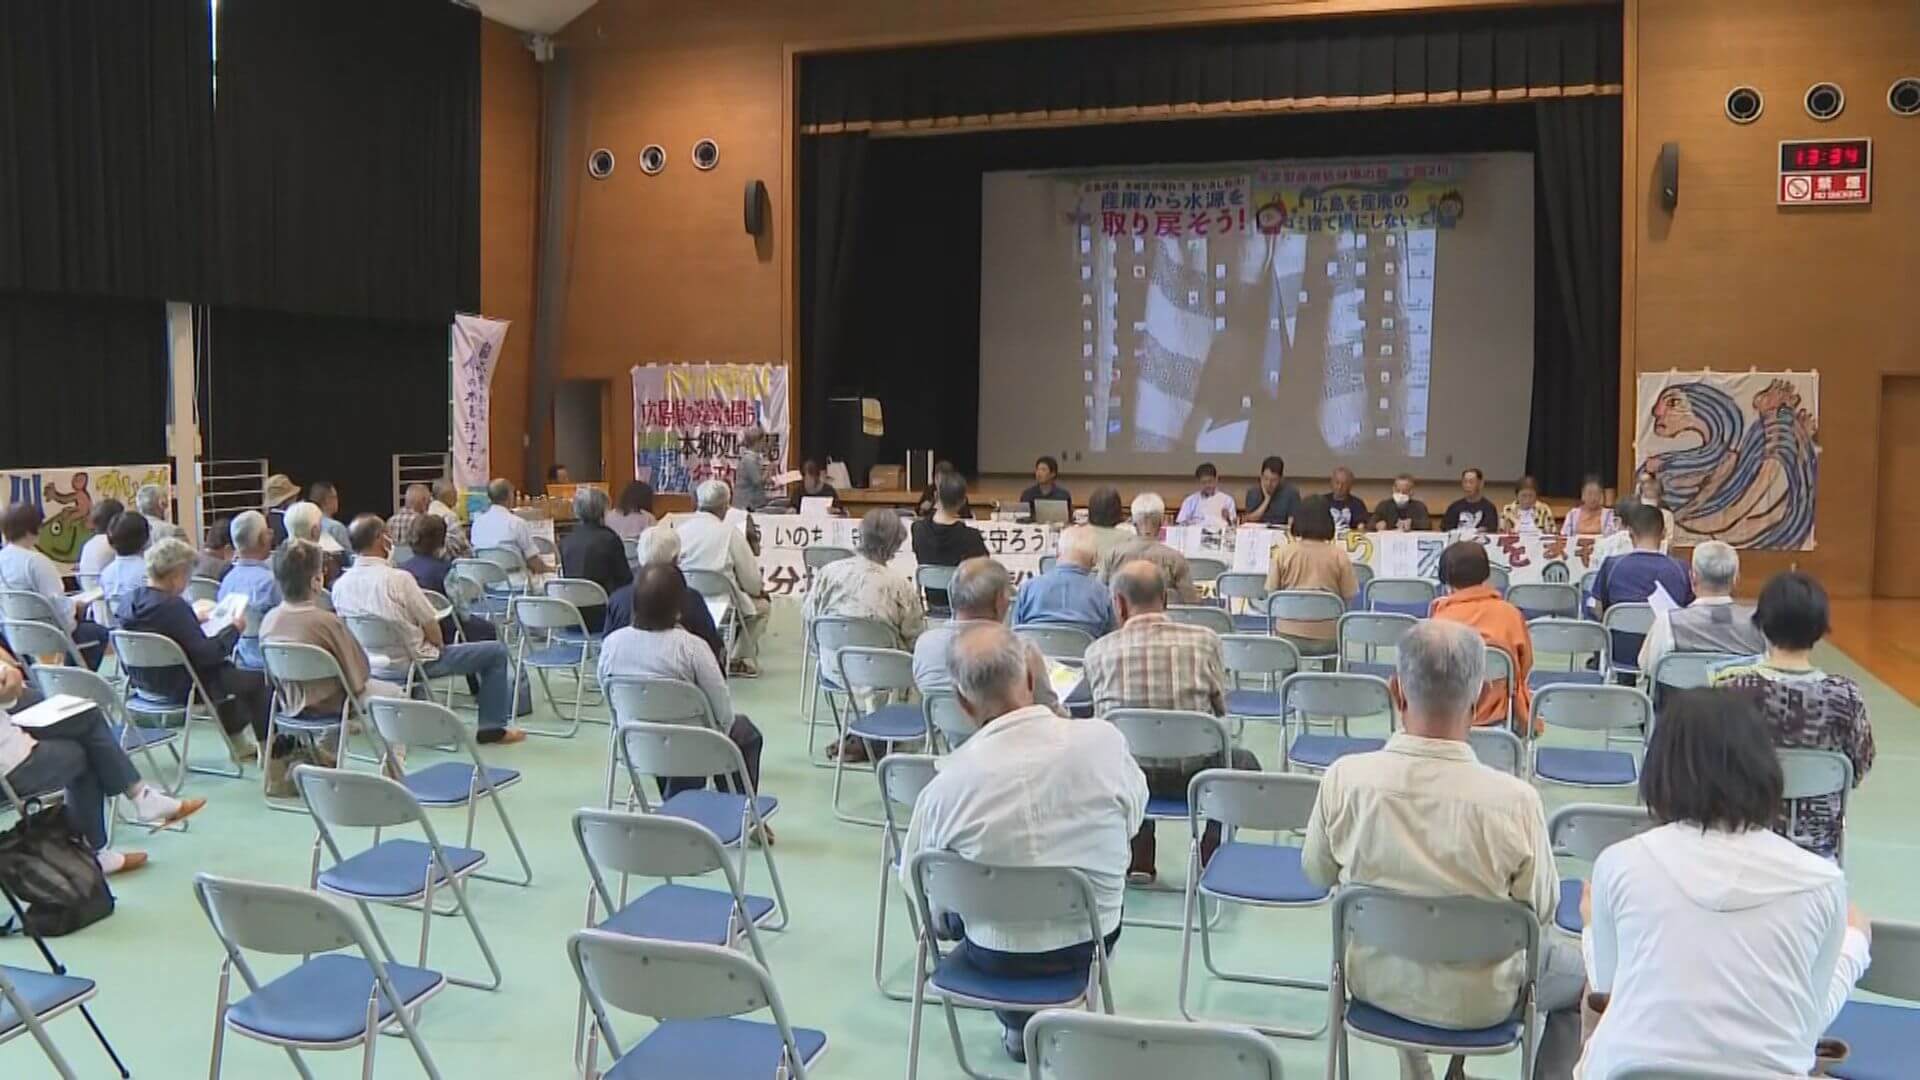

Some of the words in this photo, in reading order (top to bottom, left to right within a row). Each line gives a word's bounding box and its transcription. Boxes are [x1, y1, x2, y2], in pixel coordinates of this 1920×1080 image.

[1101, 189, 1244, 209] 産廃から水源を
[1101, 208, 1245, 237] 取り戻そう!
